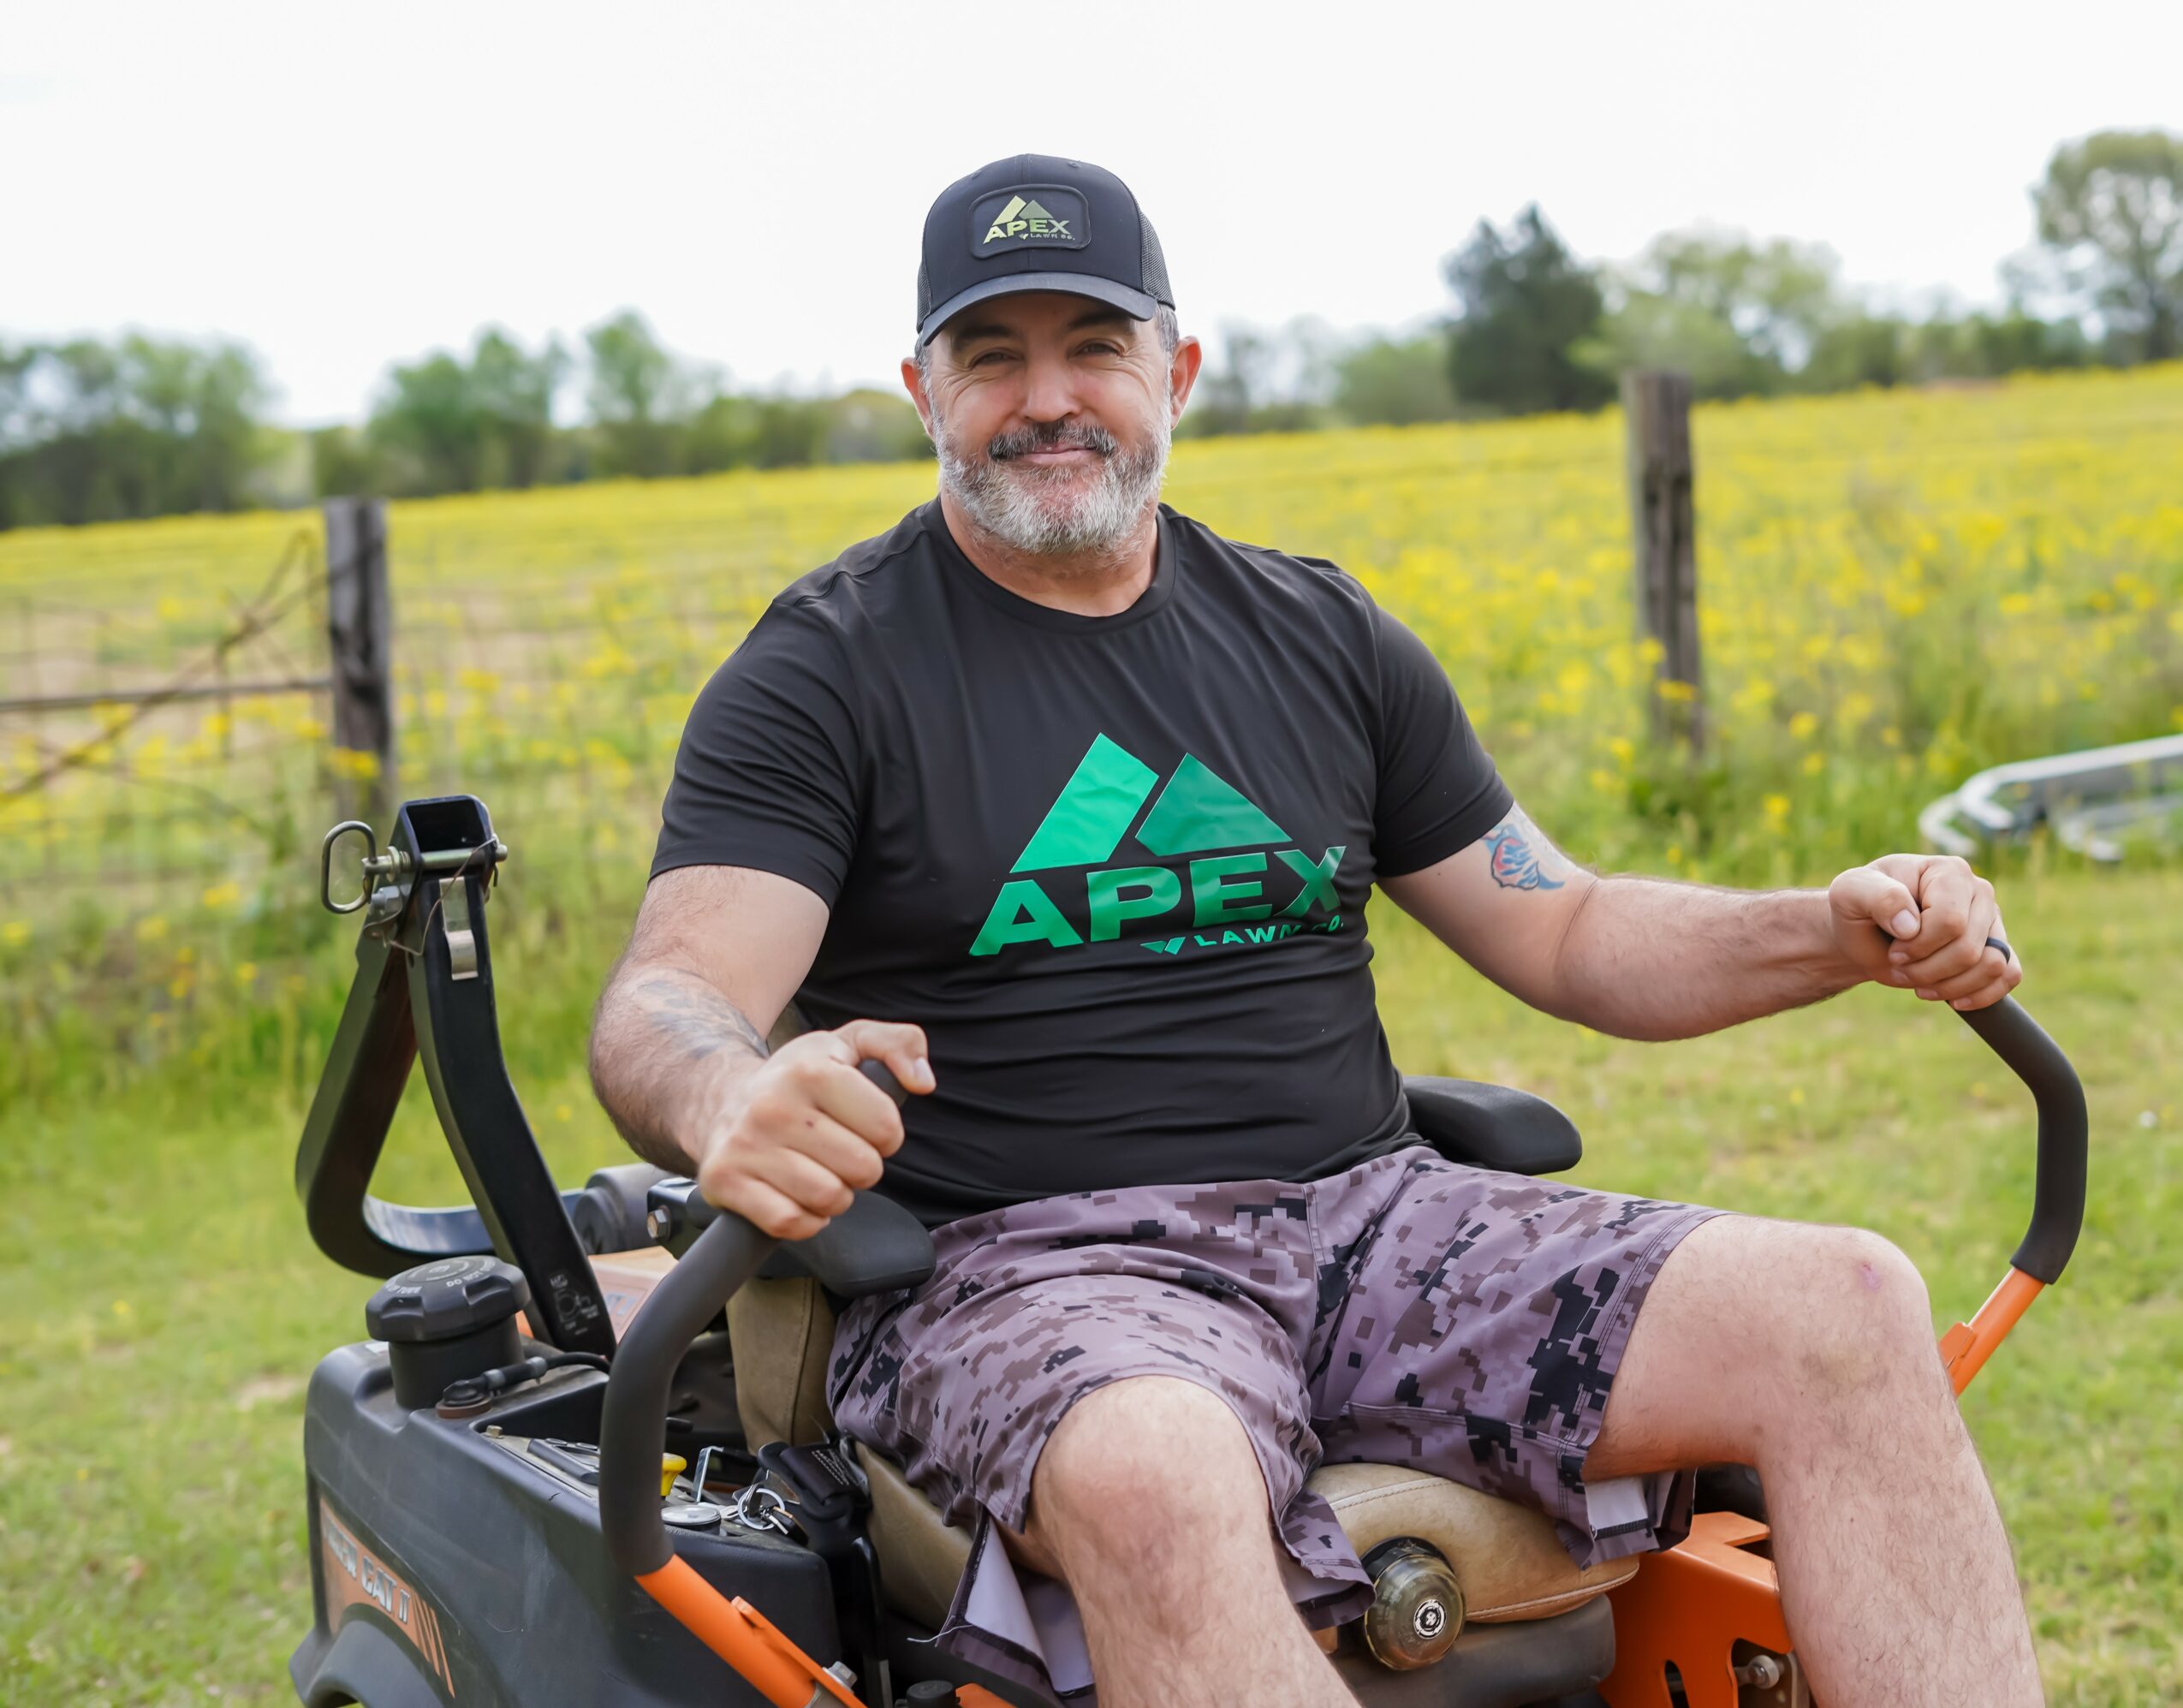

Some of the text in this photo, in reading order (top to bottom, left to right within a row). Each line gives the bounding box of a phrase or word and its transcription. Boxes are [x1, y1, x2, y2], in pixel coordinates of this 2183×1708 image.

[984, 219, 1071, 244] APEX
[969, 846, 1347, 956] APEX
[1194, 925, 1301, 947] LAWN
[361, 1555, 397, 1614] CAT
